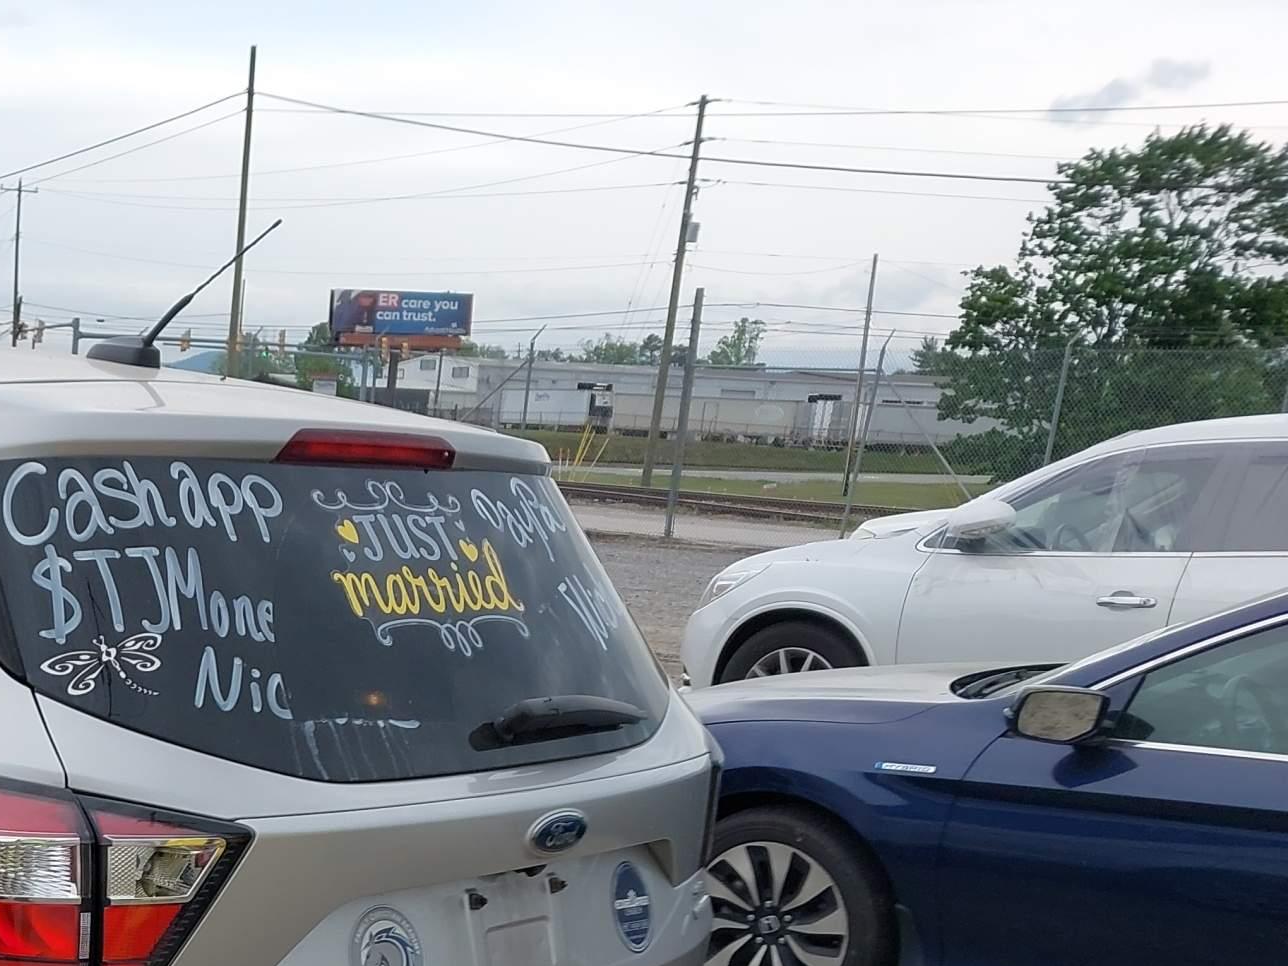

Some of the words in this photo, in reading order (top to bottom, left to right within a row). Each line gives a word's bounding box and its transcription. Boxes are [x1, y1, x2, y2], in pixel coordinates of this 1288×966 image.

[376, 310, 400, 321] can
[402, 310, 436, 322] trust.
[378, 293, 399, 306] ER
[401, 299, 431, 309] care
[434, 299, 458, 311] you
[3, 461, 176, 545] Cash
[169, 461, 283, 543] app
[353, 514, 458, 561] JUST
[334, 538, 525, 616] married
